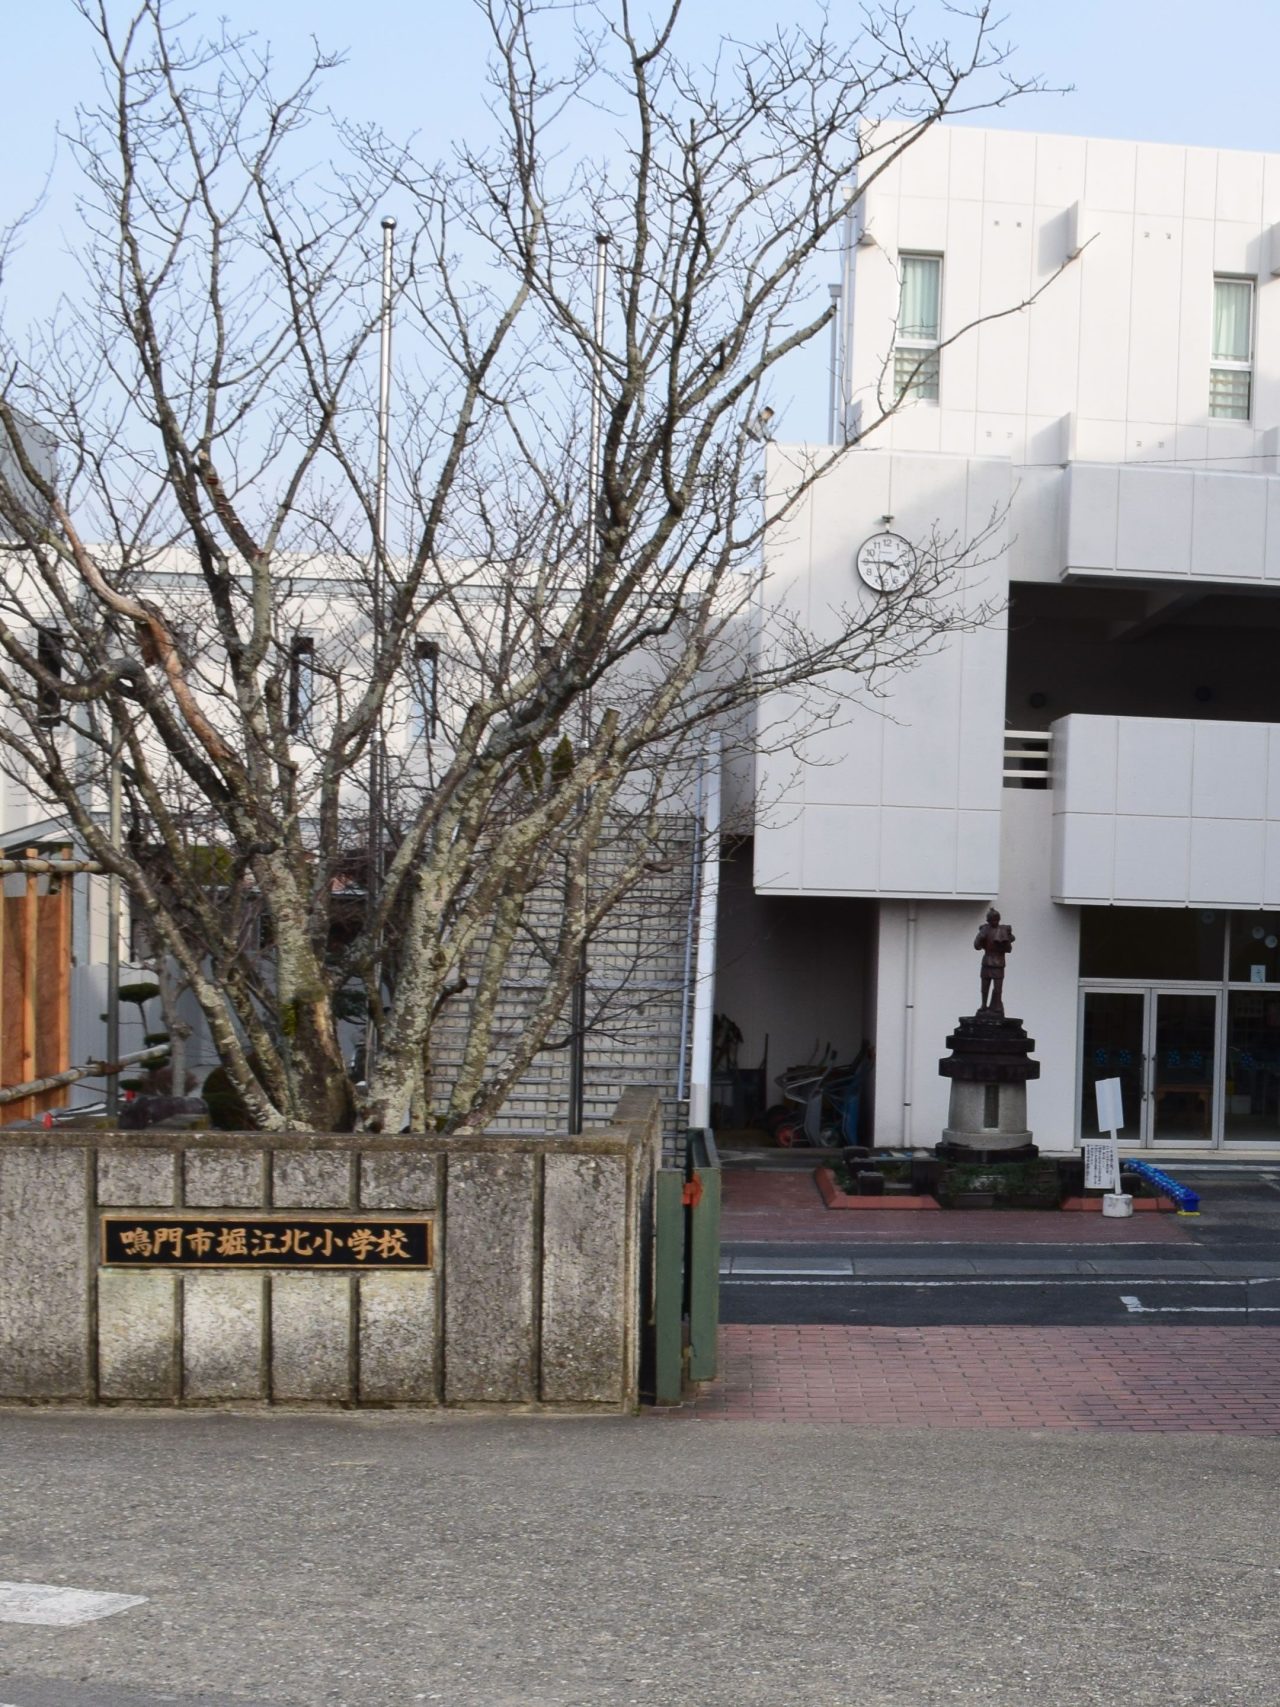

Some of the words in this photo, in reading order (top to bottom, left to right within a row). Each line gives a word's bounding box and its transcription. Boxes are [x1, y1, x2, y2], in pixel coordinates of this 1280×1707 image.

[866, 549, 875, 557] 10
[119, 1227, 411, 1260] 鳴門市堀江北小学校
